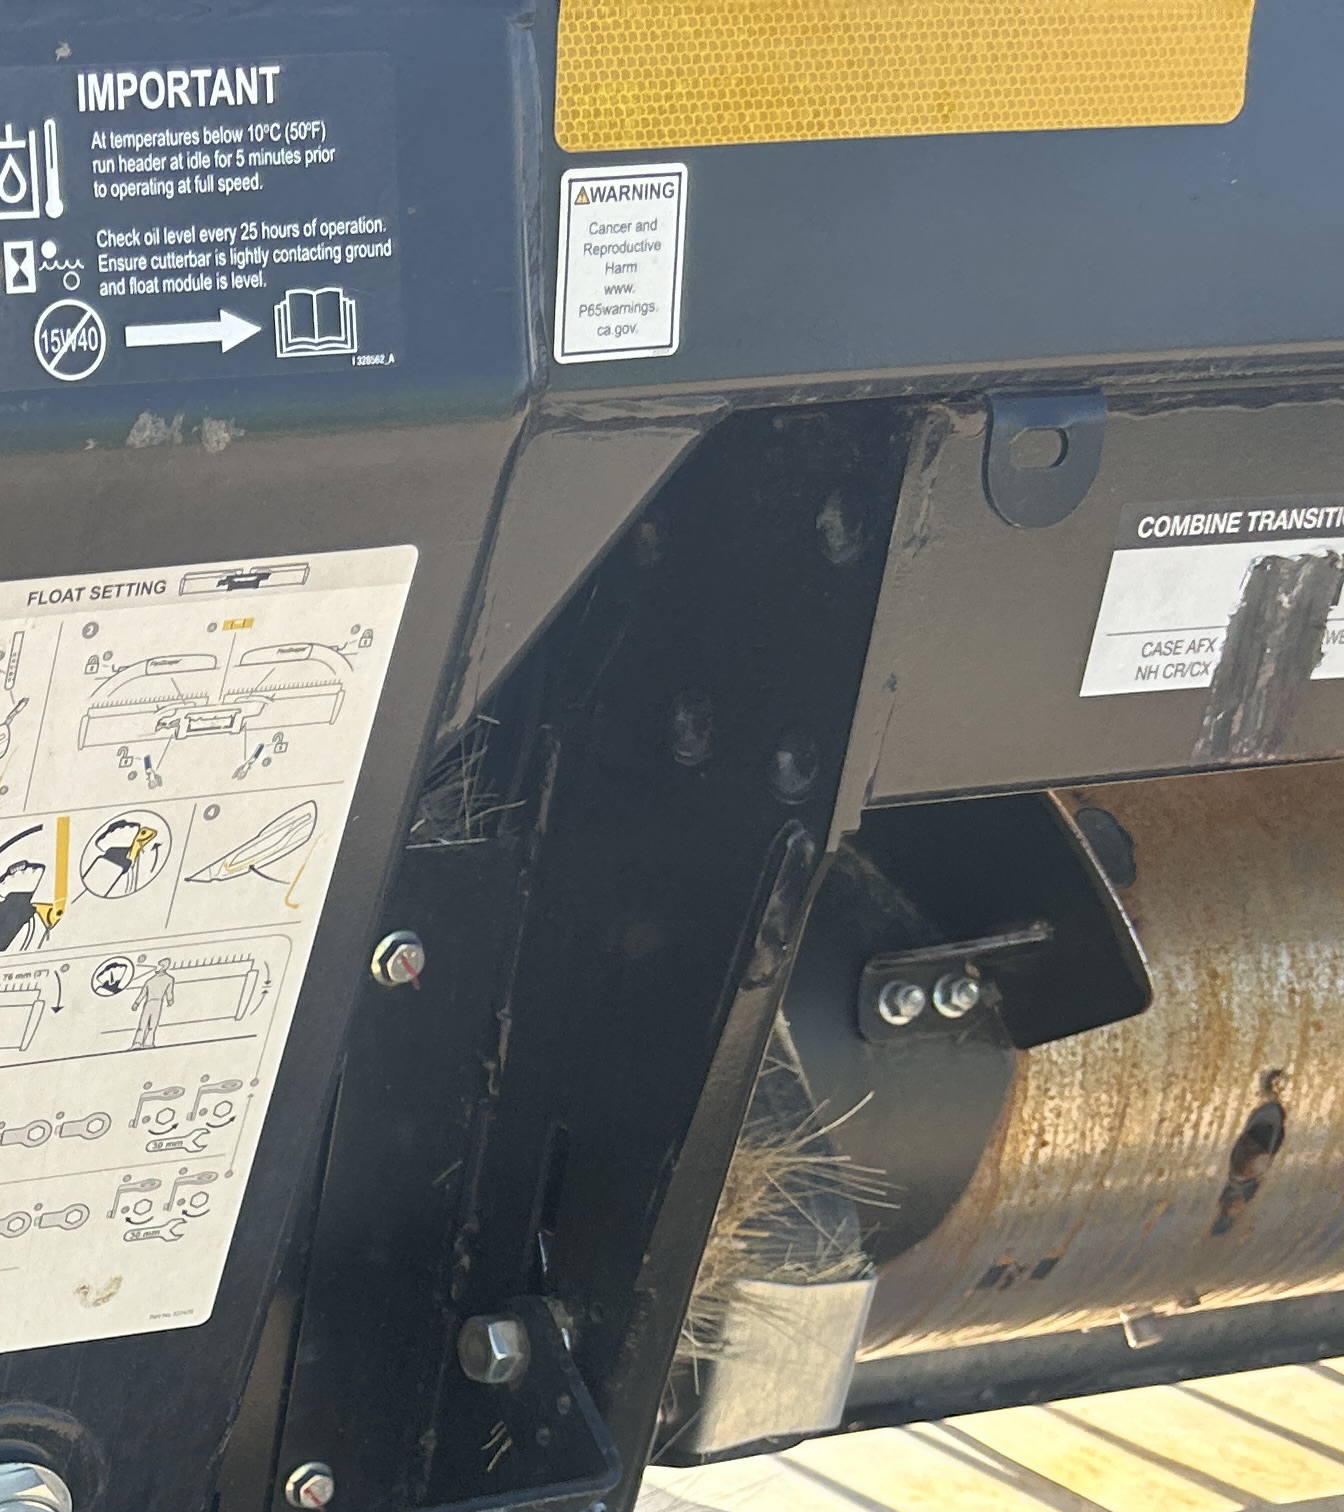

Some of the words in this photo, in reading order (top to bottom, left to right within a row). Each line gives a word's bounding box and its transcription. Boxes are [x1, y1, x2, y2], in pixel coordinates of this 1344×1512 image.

[77, 66, 280, 112] IMPORTANT
[91, 131, 107, 150] At
[110, 126, 200, 152] temperatures
[204, 125, 243, 145] below
[92, 157, 115, 174] run
[119, 153, 167, 173] header
[170, 154, 184, 171] at
[186, 150, 211, 170] idle
[214, 150, 233, 168] for
[235, 149, 246, 167] 5
[249, 146, 302, 166] minutes
[305, 144, 336, 168] prior
[94, 181, 108, 199] to
[111, 177, 175, 201] operating
[178, 177, 192, 194] at
[194, 173, 215, 193] full
[218, 172, 264, 196] speed.
[589, 182, 675, 204] WARNING
[96, 226, 141, 249] Check
[144, 226, 160, 246] oil
[163, 225, 196, 245] level
[199, 225, 237, 247] every
[240, 222, 258, 241] 25
[262, 220, 300, 240] hours
[303, 218, 318, 238] of
[319, 216, 387, 240] operation.
[588, 220, 633, 236] Cancer
[635, 217, 658, 233] and
[98, 252, 147, 273] Ensure
[150, 249, 212, 271] cutterbar
[215, 248, 227, 267] is
[230, 245, 270, 270] lightly
[272, 242, 342, 266] contacting
[345, 238, 393, 265] ground
[583, 238, 662, 259] Reproductive
[604, 262, 638, 276] Harm
[99, 277, 126, 297] and
[129, 275, 160, 295] float
[162, 272, 213, 293] module
[216, 271, 228, 290] is
[231, 269, 267, 290] level.
[603, 283, 636, 296] www.
[578, 301, 660, 318] P65warnings.
[41, 326, 99, 354] 15W40
[1137, 510, 1243, 539] COMBINE
[1247, 506, 1344, 533] TRANSITI
[26, 586, 86, 607] FLOAT
[89, 579, 168, 601] SETTING
[1141, 639, 1183, 658] CASE
[1184, 637, 1219, 655] AFX
[1134, 664, 1159, 681] NH
[1162, 661, 1213, 680] CR/CX
